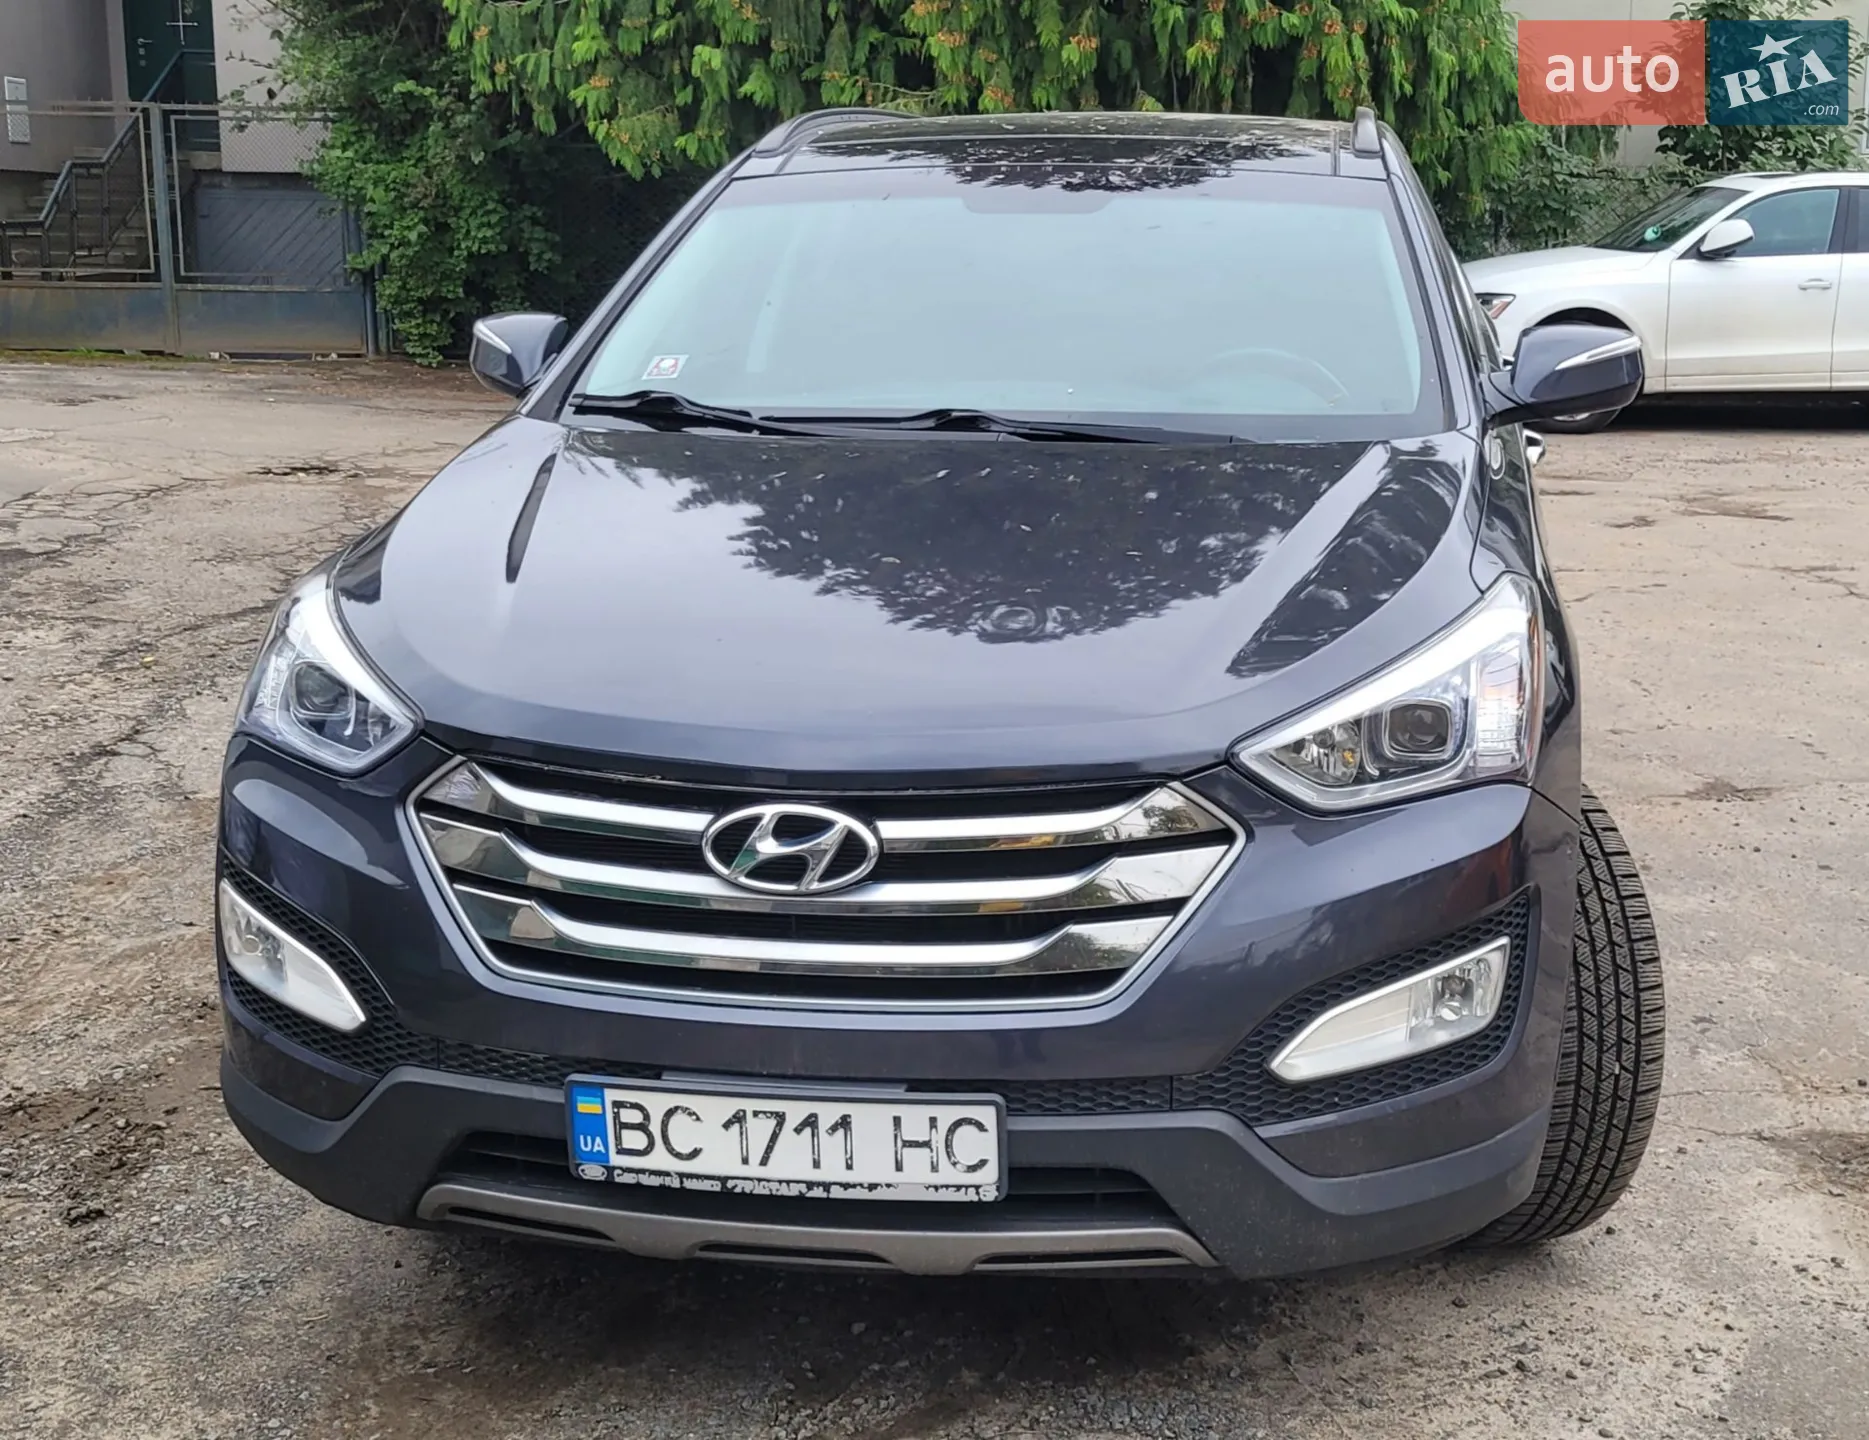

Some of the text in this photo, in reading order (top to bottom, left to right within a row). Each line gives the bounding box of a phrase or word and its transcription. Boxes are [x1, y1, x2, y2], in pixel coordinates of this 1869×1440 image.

[579, 1135, 606, 1153] UA
[611, 1100, 990, 1174] BC 1711 HC
